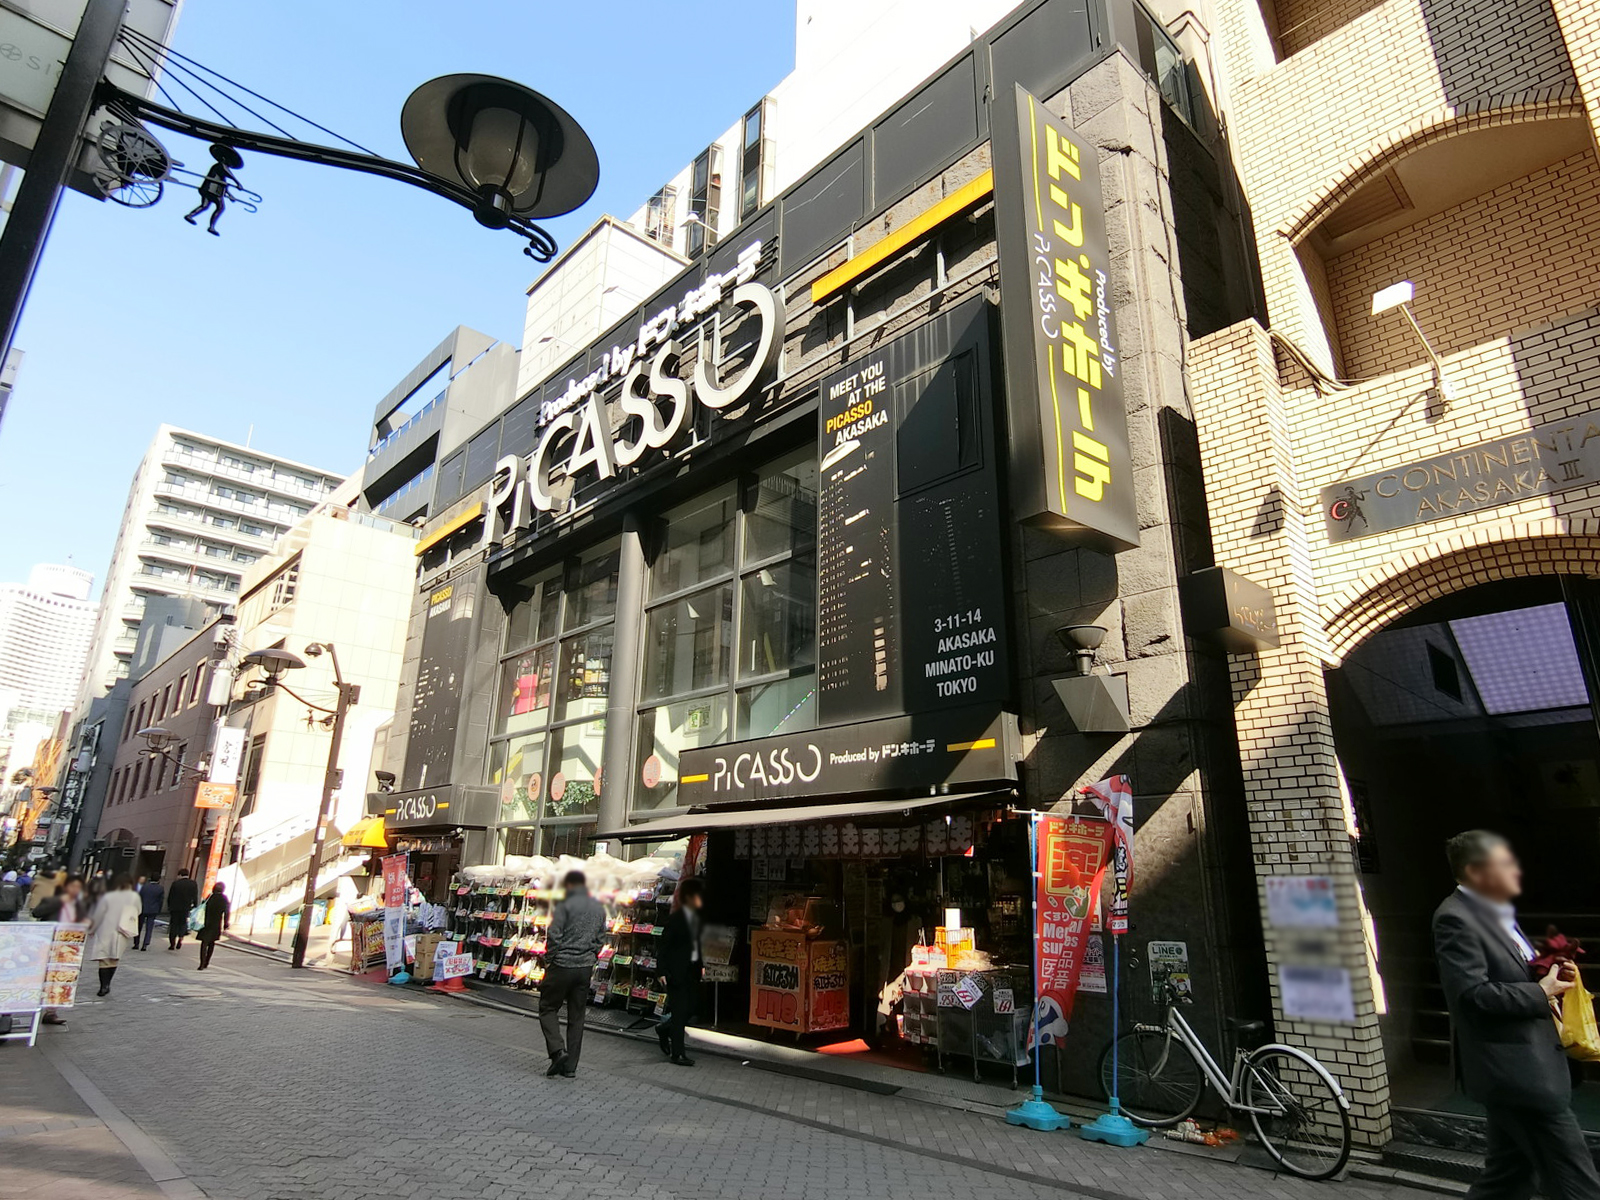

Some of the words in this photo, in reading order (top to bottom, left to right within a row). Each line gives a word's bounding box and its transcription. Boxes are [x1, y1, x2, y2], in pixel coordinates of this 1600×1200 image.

[611, 344, 636, 376] by
[830, 373, 859, 400] MEET
[861, 361, 883, 383] YOU
[848, 388, 862, 407] AT
[864, 376, 886, 398] THE
[826, 400, 873, 434] PICASSO
[835, 410, 888, 446] AKASAKA
[1416, 467, 1557, 518] AKASAKA
[934, 608, 982, 633] 3-11-14
[937, 627, 996, 654] AKASAKA
[925, 650, 994, 678] MINATO-KU
[936, 676, 977, 697] TOKYO
[829, 748, 867, 765] Produced
[868, 747, 880, 763] by
